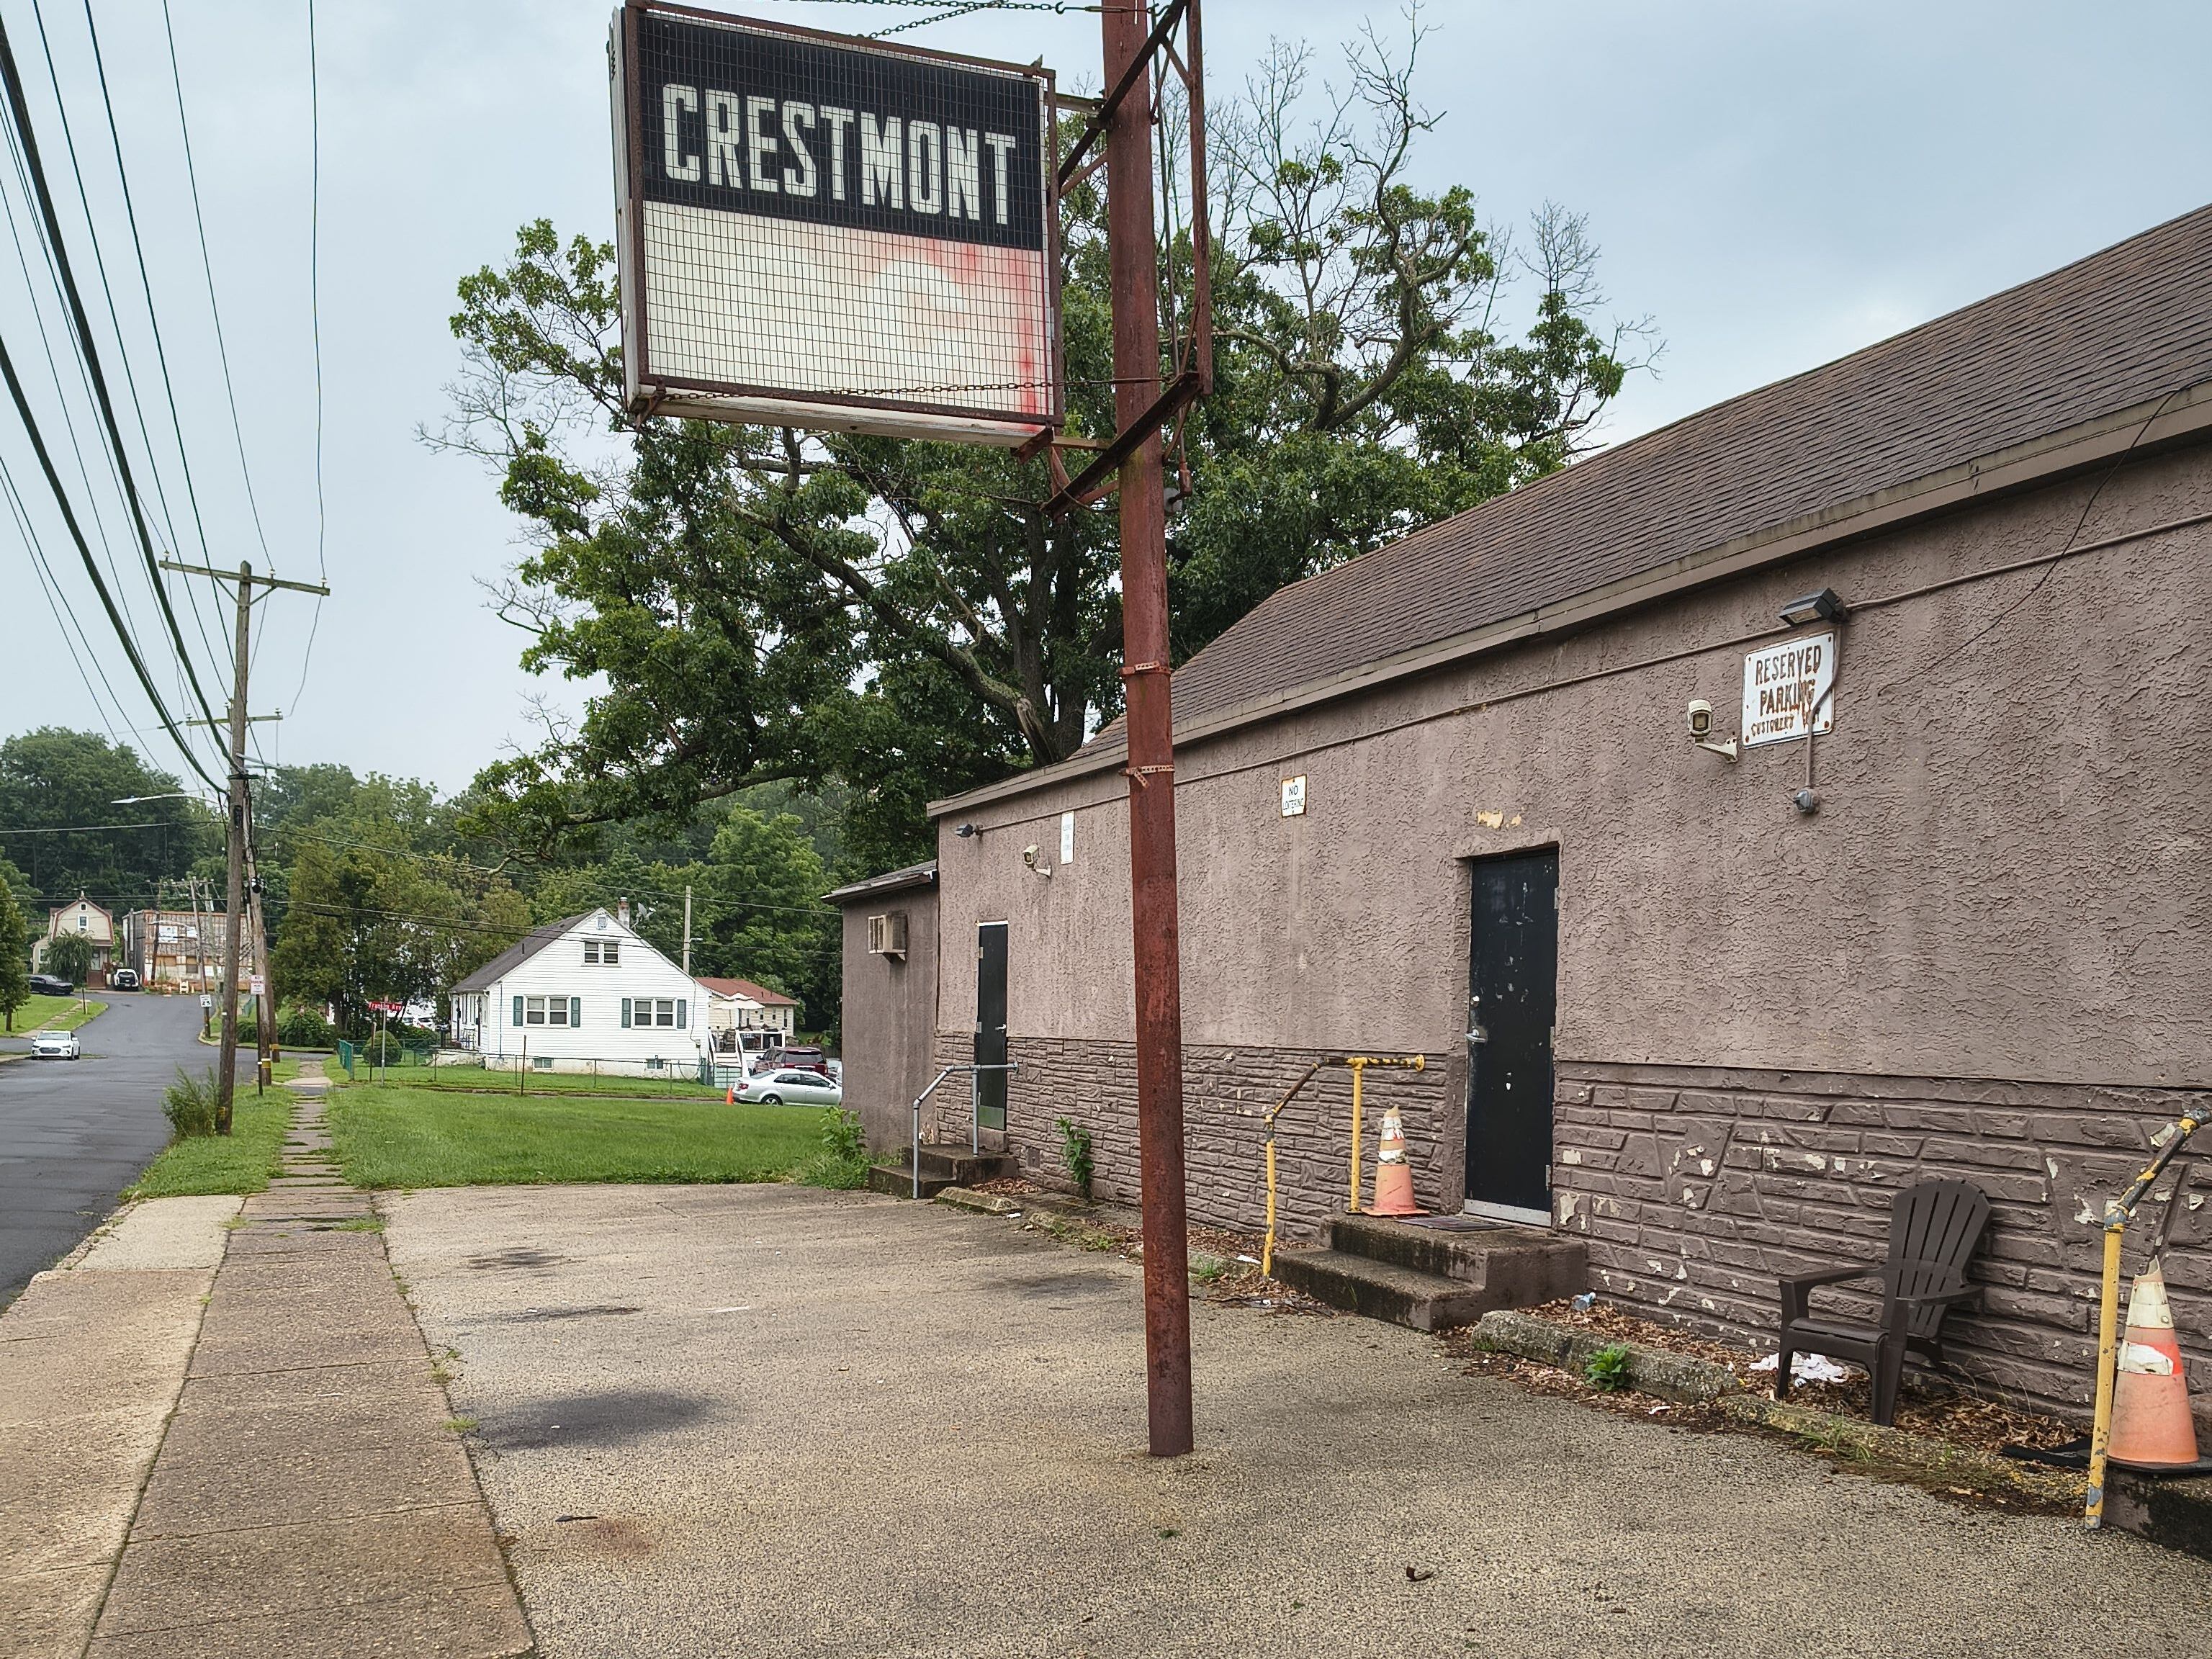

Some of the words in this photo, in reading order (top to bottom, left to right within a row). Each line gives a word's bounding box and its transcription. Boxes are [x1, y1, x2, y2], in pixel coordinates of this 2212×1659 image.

[662, 83, 1016, 225] CRESTMONT
[1755, 644, 1822, 685] RESERVED
[1760, 679, 1816, 716] PARKING
[1282, 797, 1304, 811] LOITERING
[1288, 785, 1298, 796] NO
